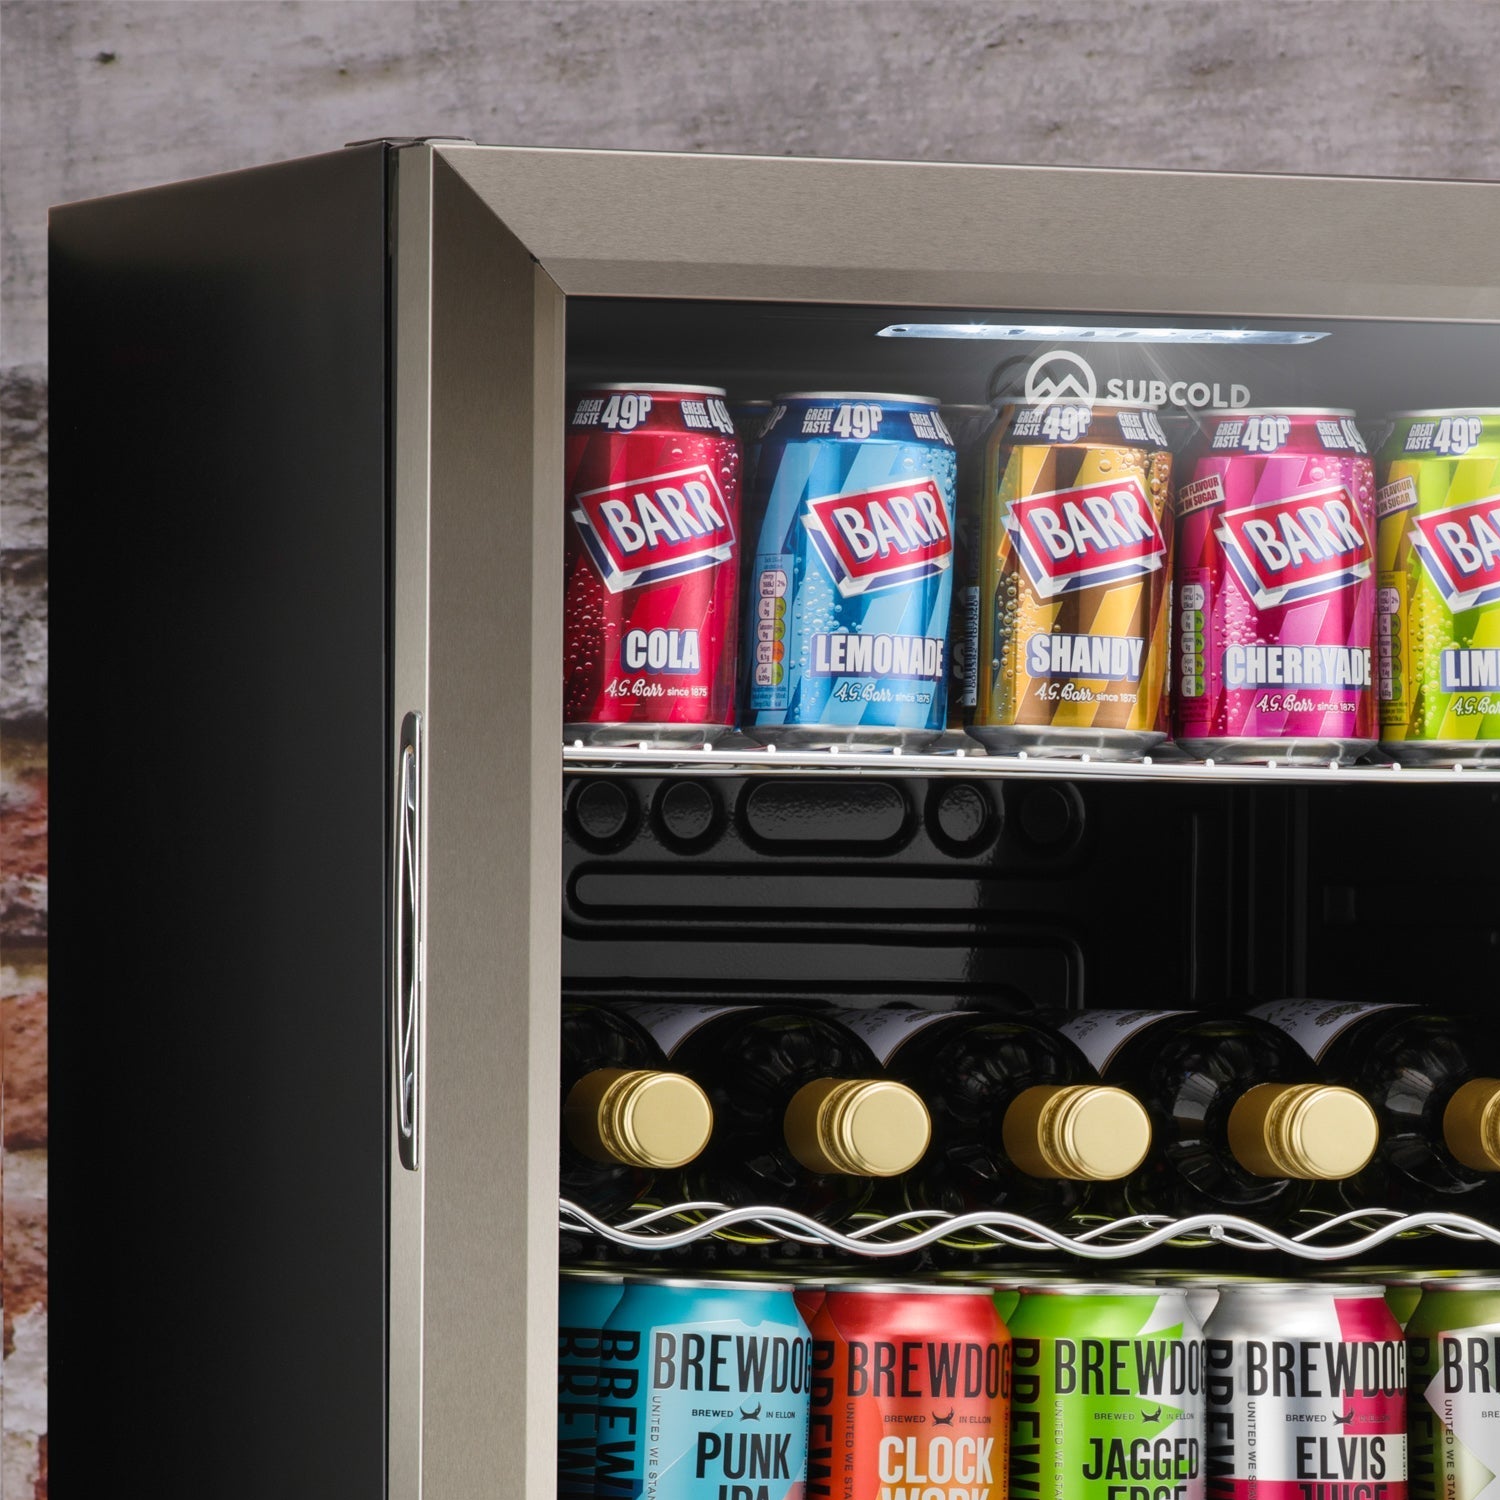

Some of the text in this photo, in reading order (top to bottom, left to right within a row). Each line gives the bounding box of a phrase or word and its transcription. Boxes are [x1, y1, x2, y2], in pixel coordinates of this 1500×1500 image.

[1107, 379, 1250, 408] SUBCOLD
[576, 400, 604, 412] GREAT
[680, 400, 706, 415] GREAT
[805, 408, 834, 422] GREAT
[572, 412, 599, 425] TASTE
[684, 414, 712, 429] VALUE
[1016, 410, 1043, 425] GREAT
[801, 421, 831, 434] TASTE
[1013, 424, 1040, 437] TASTE
[1215, 422, 1243, 436] GREAT
[1409, 423, 1435, 437] GREAT
[1212, 435, 1241, 448] TASTE
[1405, 436, 1432, 450] TASTE
[1189, 475, 1220, 495] FLAVOUR
[1383, 479, 1413, 498] FLAVOUR
[599, 480, 725, 553] BARR
[833, 490, 947, 560] BARR
[1029, 490, 1155, 560] BARR
[1243, 500, 1364, 571] BARR
[625, 629, 700, 670] COLA
[815, 635, 945, 678] LEMONADE
[1031, 634, 1144, 677] SHANDY
[1226, 646, 1372, 686] CHERRYADE
[631, 678, 666, 697] Barr
[667, 687, 690, 697] since
[691, 687, 708, 697] 1875
[1283, 694, 1316, 712] Barr
[1317, 703, 1338, 712] since
[1340, 703, 1356, 712] 1875
[653, 1332, 812, 1395] BREWDOG
[847, 1341, 1011, 1399] BREWDOG
[1055, 1339, 1206, 1396] BREWDOG
[1247, 1340, 1405, 1398] BREWDOG
[651, 1396, 660, 1442] UNITED
[691, 1408, 796, 1419] BREWED IN ELLON
[884, 1414, 992, 1424] BREWED IN ELLON
[1094, 1413, 1135, 1421] BREWED
[1285, 1414, 1327, 1423] BREWED
[649, 1447, 658, 1466] WE
[695, 1431, 792, 1480] PUNK
[878, 1436, 995, 1484] CLOCK
[1083, 1438, 1199, 1480] JAGGED
[1296, 1436, 1386, 1480] ELVIS
